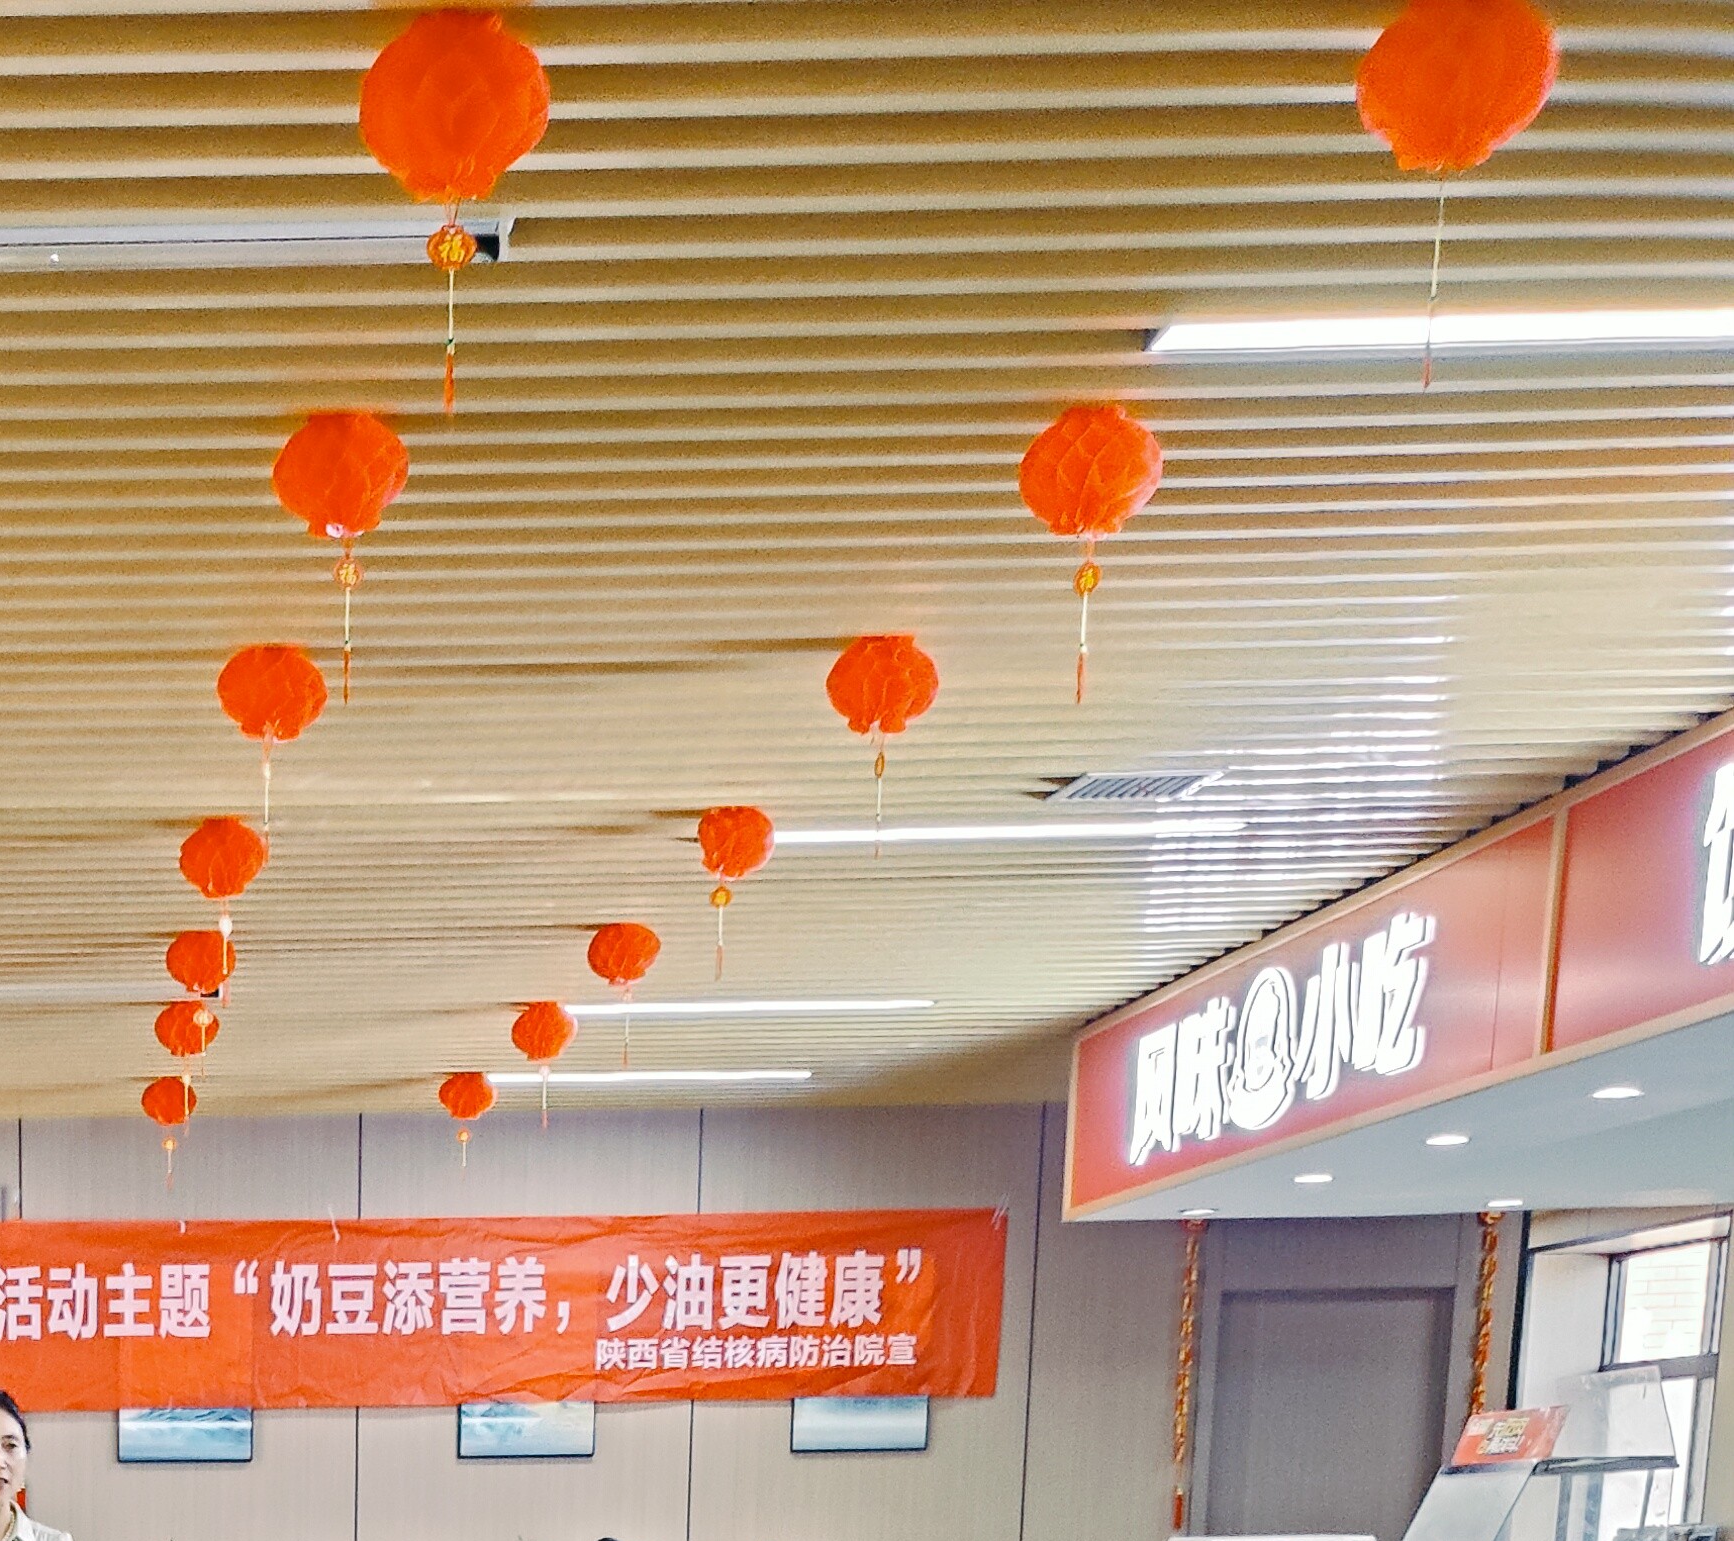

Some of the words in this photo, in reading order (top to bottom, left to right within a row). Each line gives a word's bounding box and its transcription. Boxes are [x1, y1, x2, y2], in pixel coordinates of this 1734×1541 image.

[439, 233, 465, 262] 福
[1129, 996, 1237, 1166] 风味
[1293, 911, 1438, 1100] 小吃
[594, 1335, 917, 1371] 陕西省结核病防治院宣
